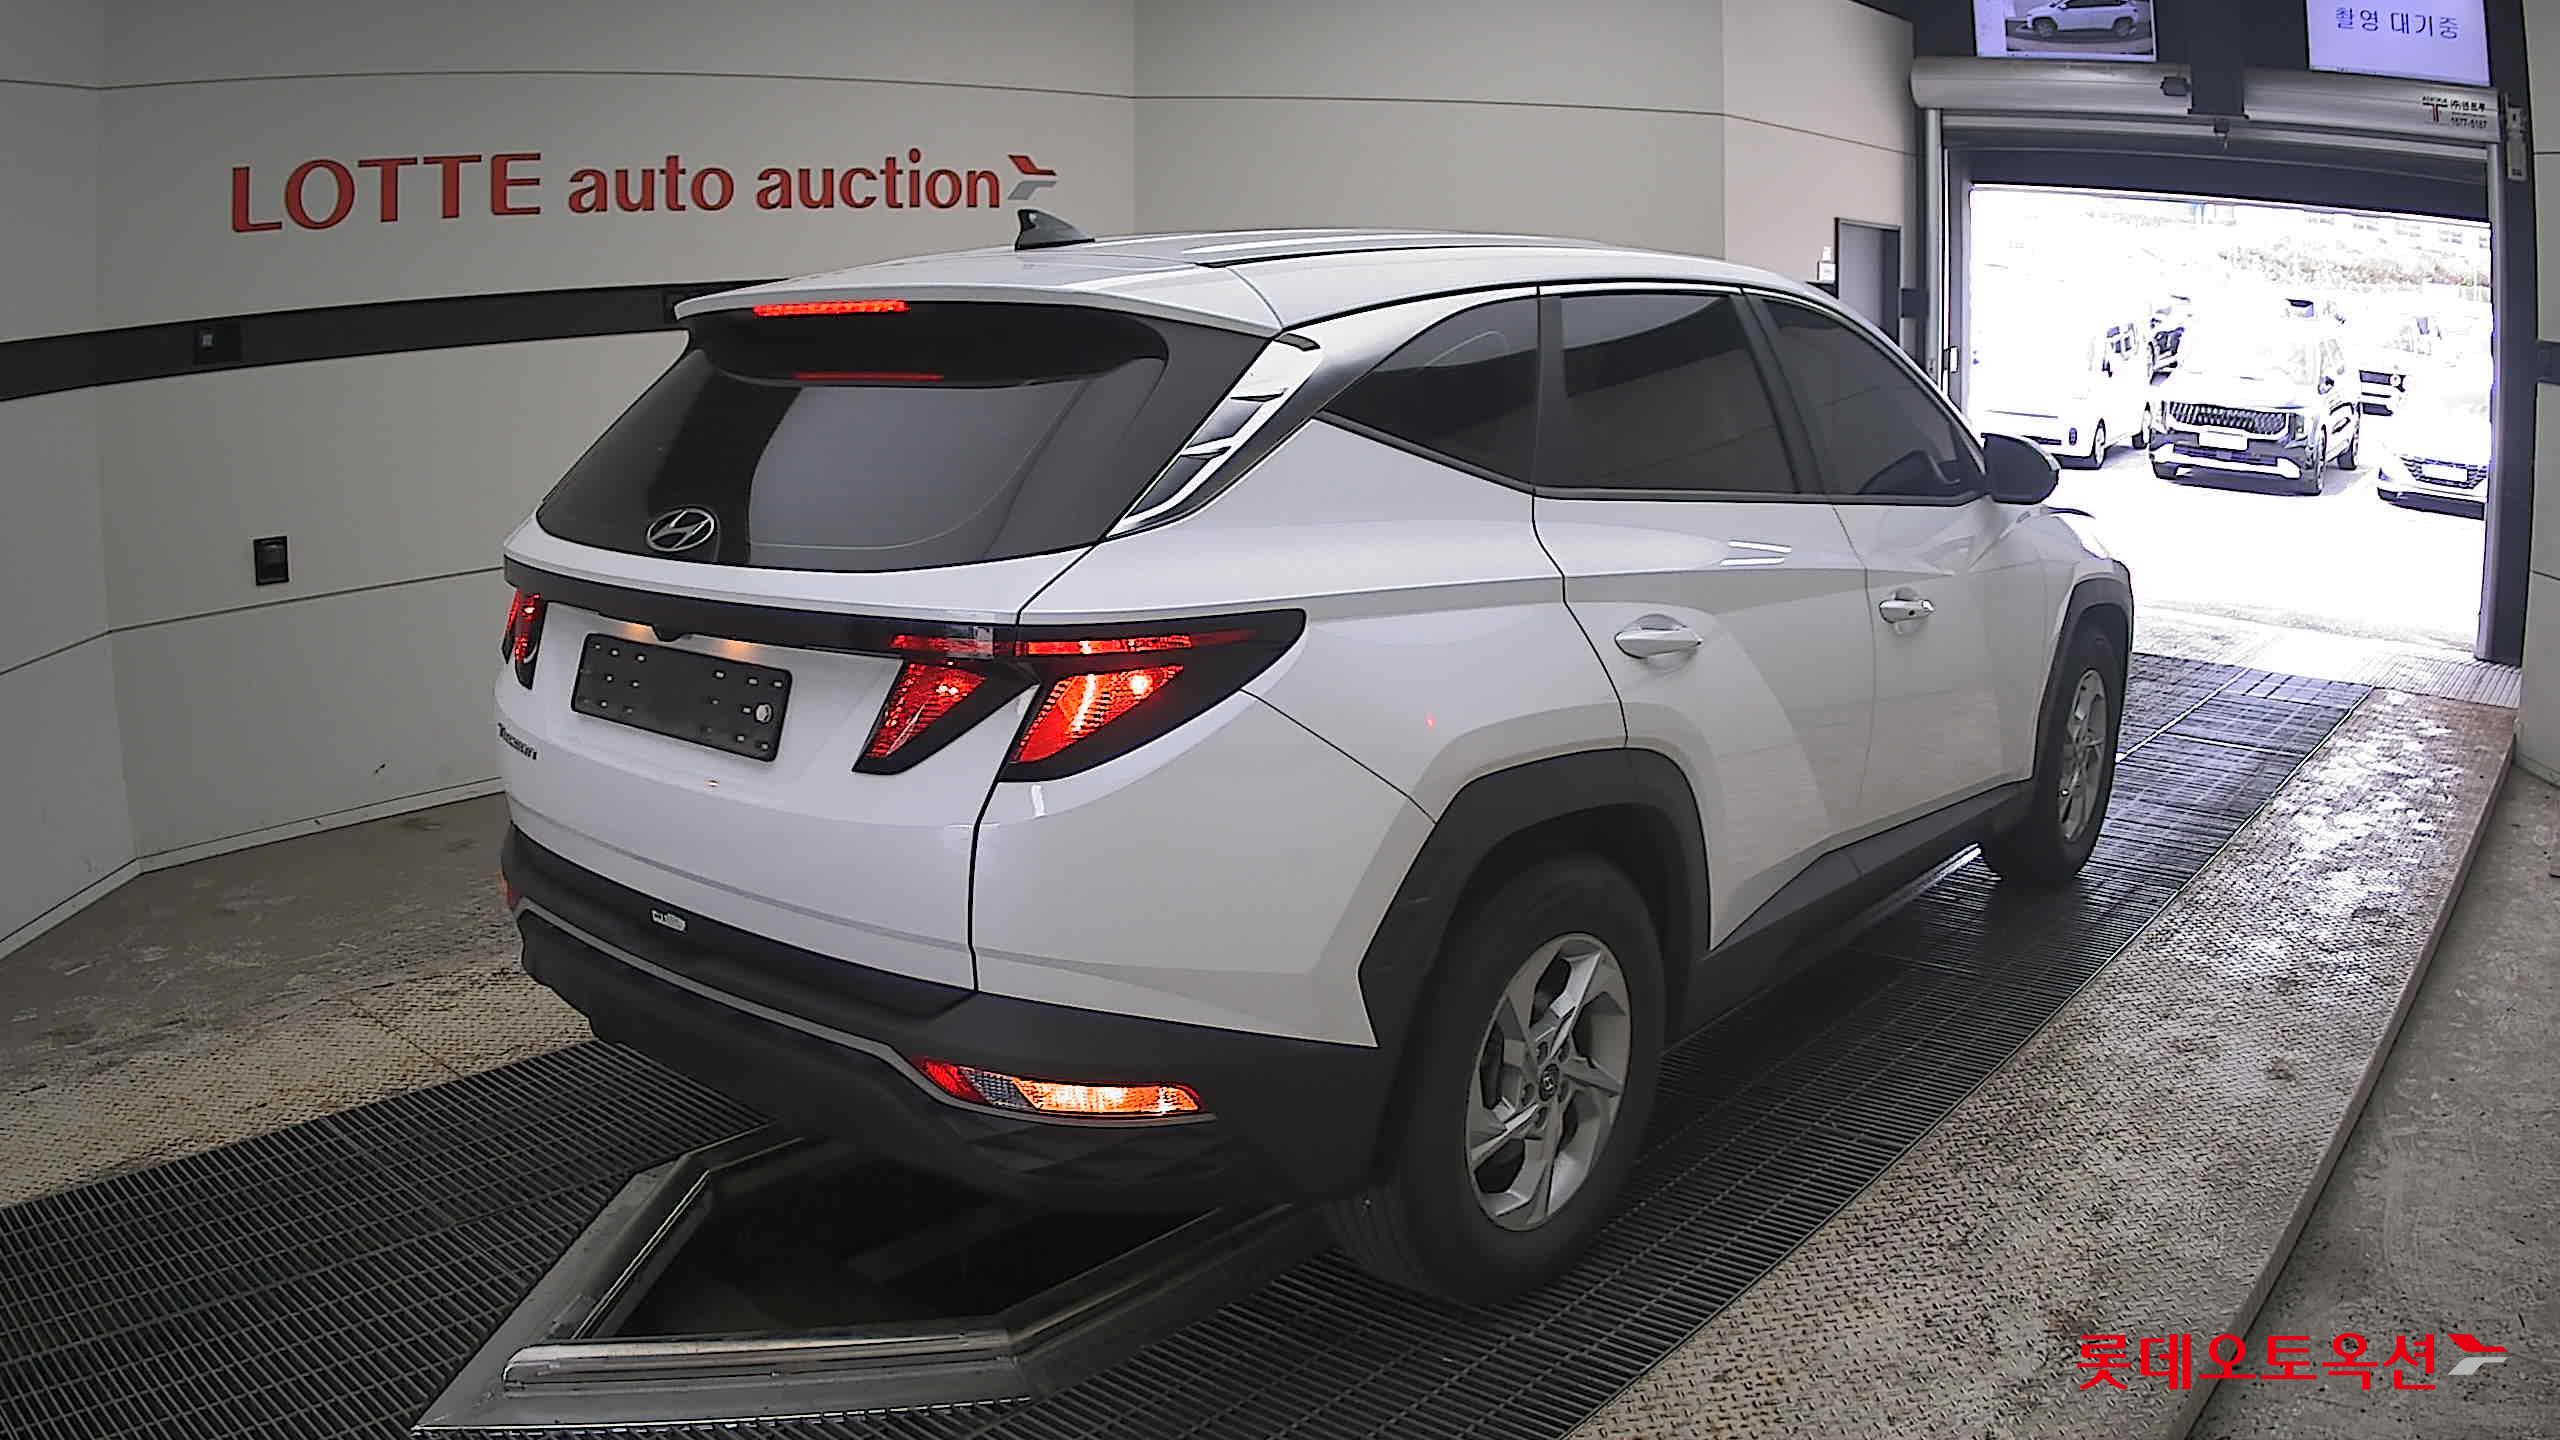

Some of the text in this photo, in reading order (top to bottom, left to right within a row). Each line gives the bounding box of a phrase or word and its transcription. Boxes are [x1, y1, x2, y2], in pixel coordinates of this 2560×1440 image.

[2336, 7, 2459, 40] 촬영 대기중
[231, 148, 1002, 233] LOTTE auto auction
